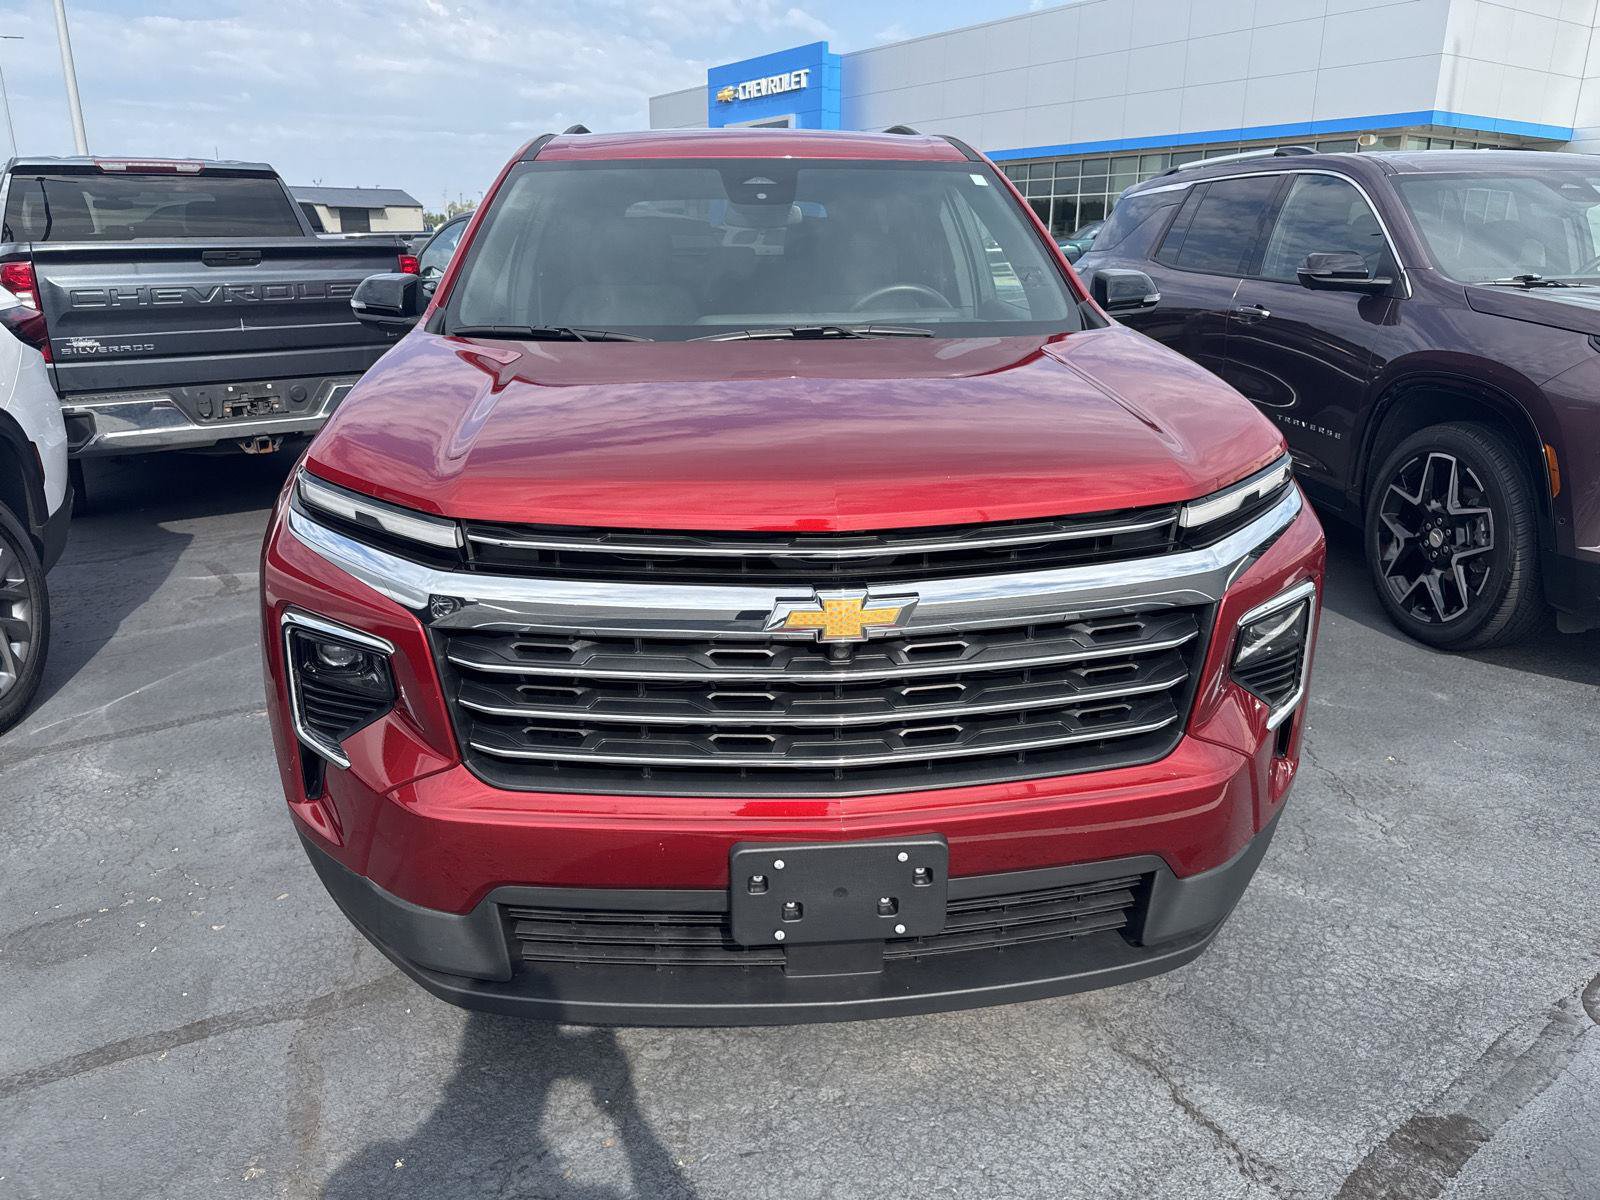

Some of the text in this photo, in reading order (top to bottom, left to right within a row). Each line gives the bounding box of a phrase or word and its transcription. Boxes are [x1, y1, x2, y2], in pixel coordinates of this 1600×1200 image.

[737, 69, 809, 100] CHEVROLET
[70, 283, 358, 307] CHEVROLE
[61, 343, 155, 355] SILVERADO
[1277, 414, 1342, 439] TRAVERSE
